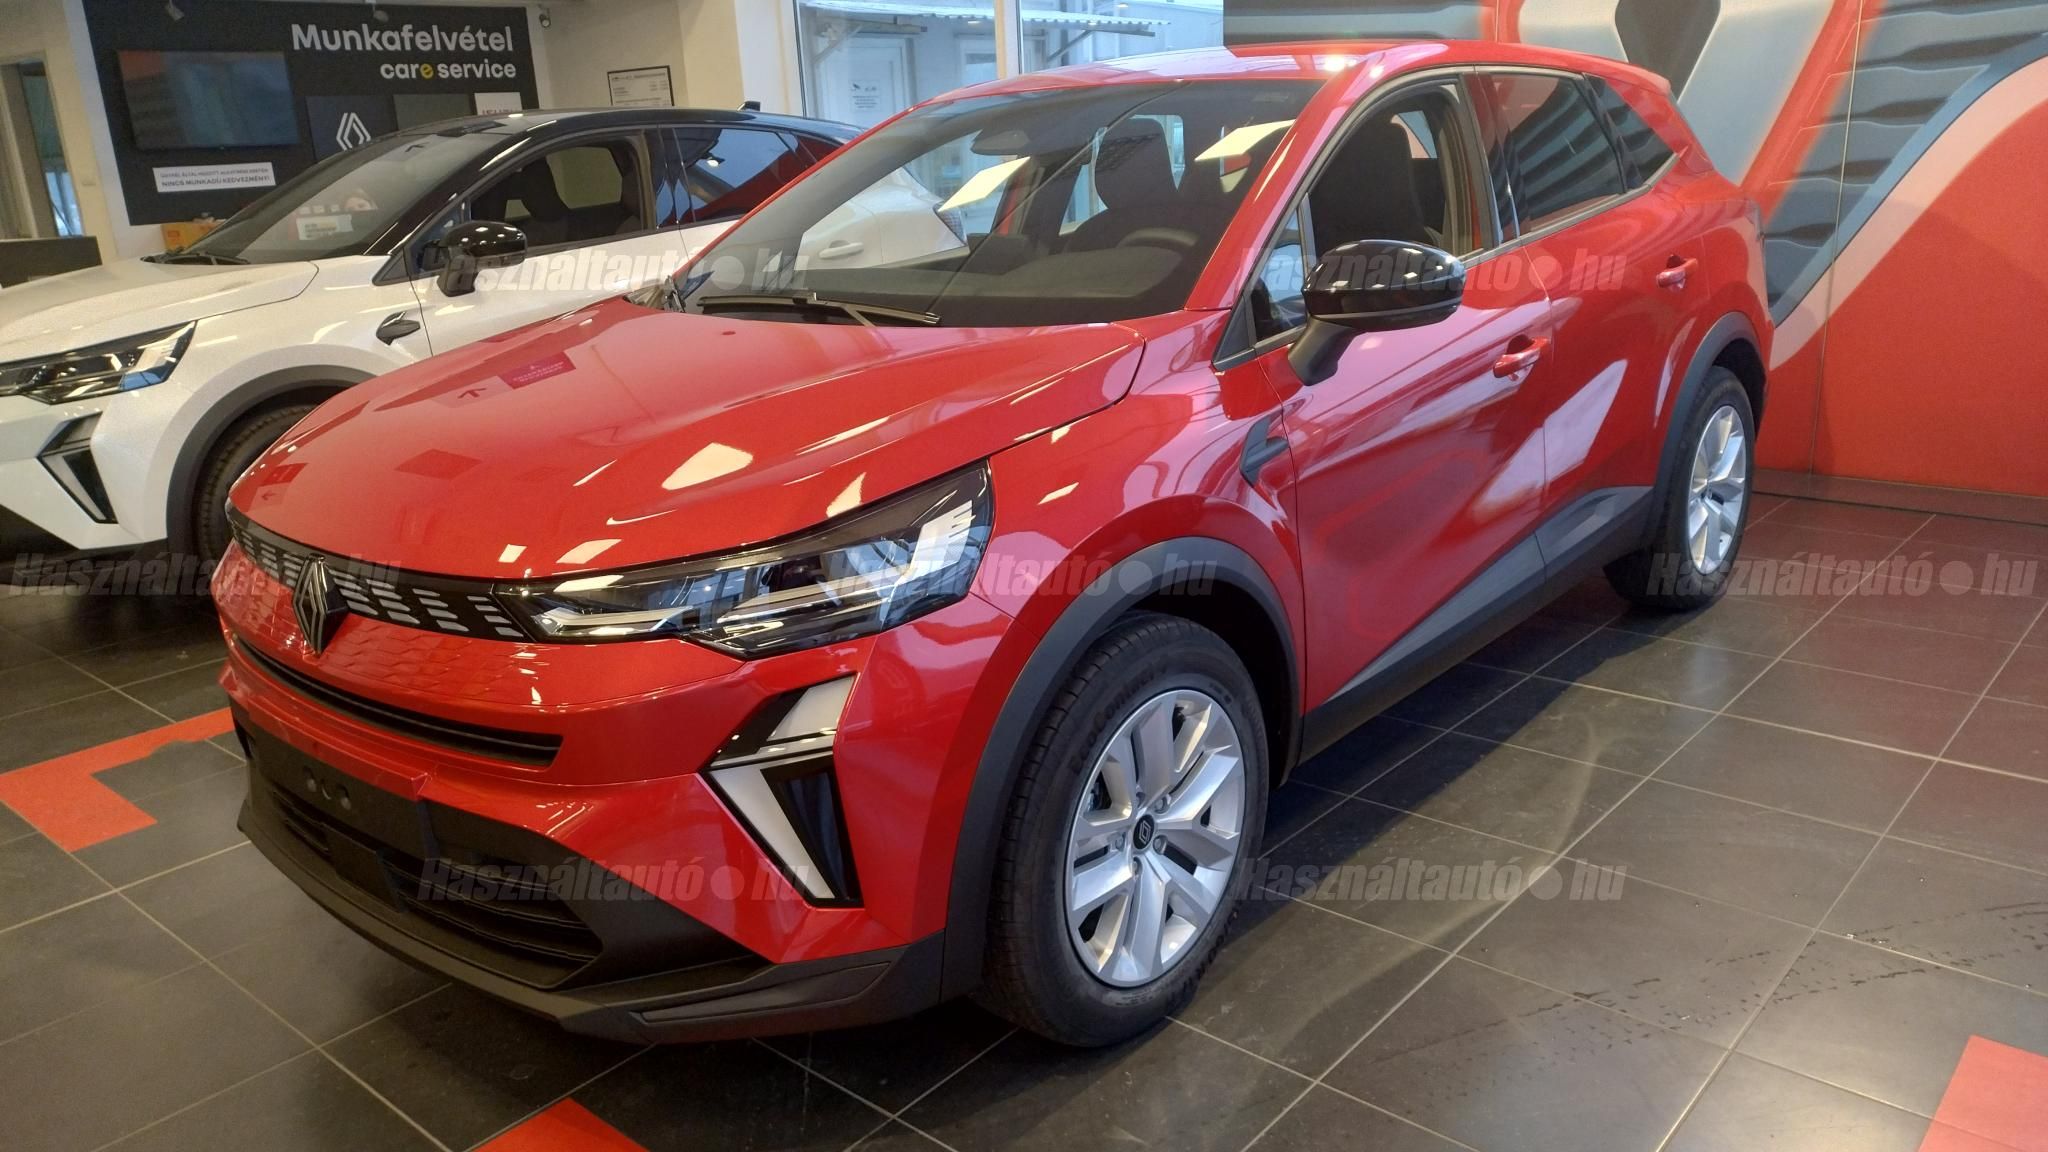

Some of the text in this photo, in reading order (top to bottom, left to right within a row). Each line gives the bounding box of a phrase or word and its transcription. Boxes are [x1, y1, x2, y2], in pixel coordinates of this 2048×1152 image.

[291, 23, 513, 51] Munkafelvétel
[380, 58, 516, 79] care service
